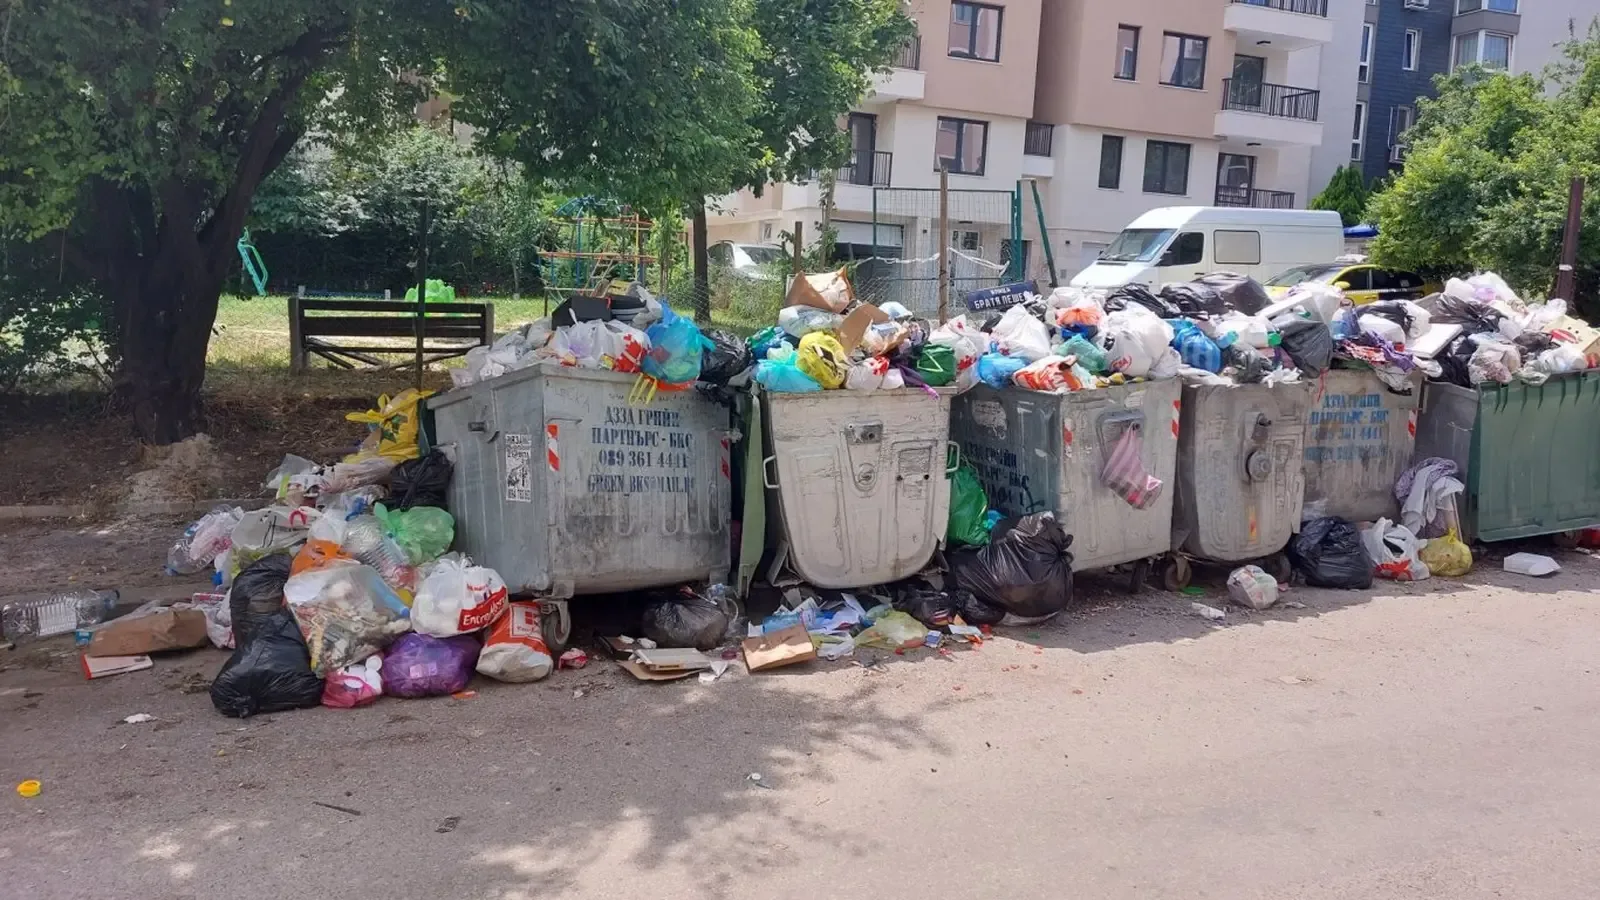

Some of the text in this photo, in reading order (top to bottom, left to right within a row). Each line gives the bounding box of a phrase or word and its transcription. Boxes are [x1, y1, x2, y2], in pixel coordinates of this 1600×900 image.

[974, 296, 1001, 309] БРАТЯ
[591, 427, 659, 448] ПАРТНЪРС
[598, 449, 625, 467] 089
[628, 450, 651, 468] 361
